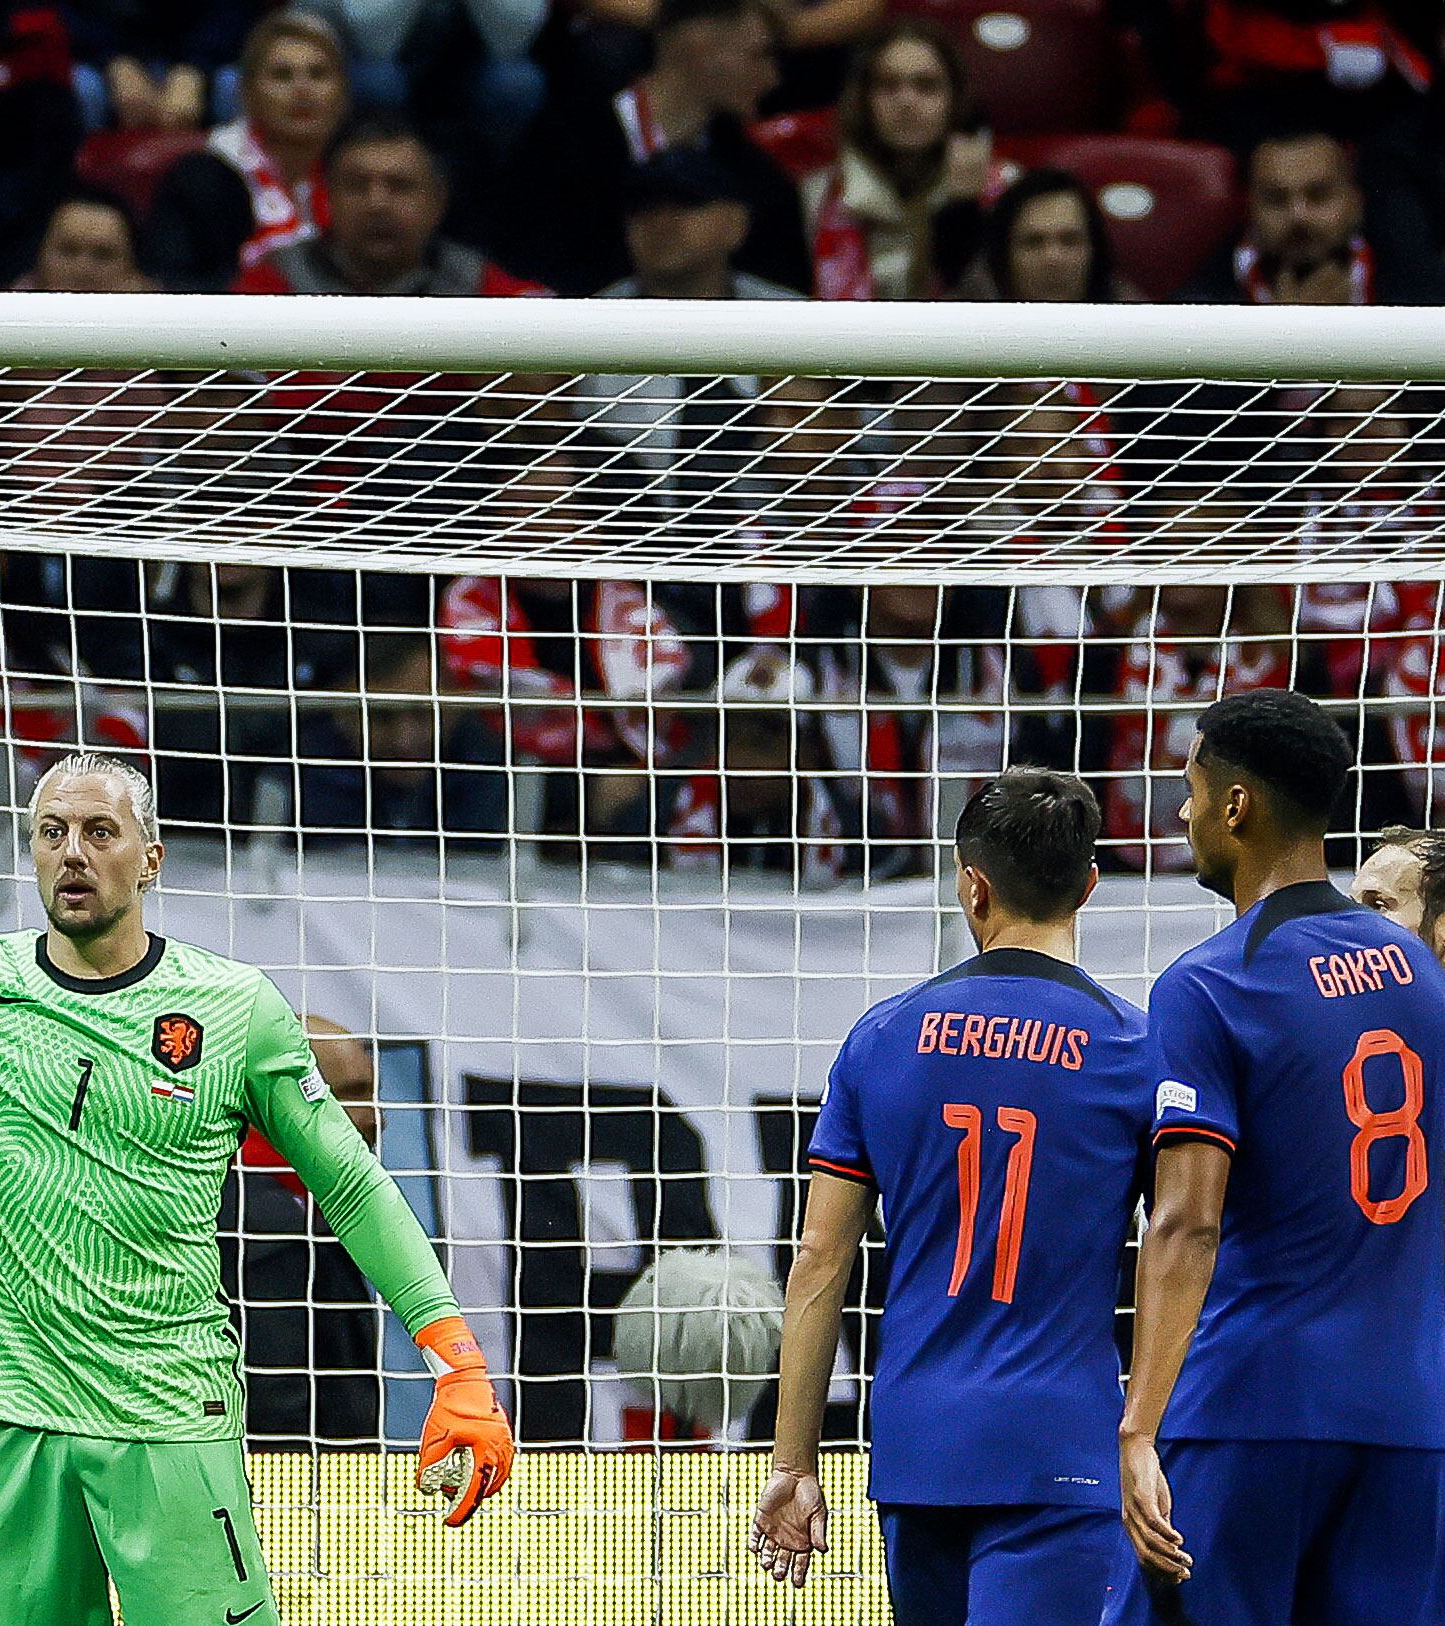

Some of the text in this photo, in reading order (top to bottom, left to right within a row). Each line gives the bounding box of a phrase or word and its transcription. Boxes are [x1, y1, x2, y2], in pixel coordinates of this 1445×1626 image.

[1309, 943, 1414, 998] GAKPO
[917, 1012, 1089, 1071] BERGHUIS
[68, 1057, 94, 1131] 1
[1342, 1029, 1429, 1225] 8
[942, 1103, 1037, 1304] 11
[211, 1507, 248, 1582] 1
